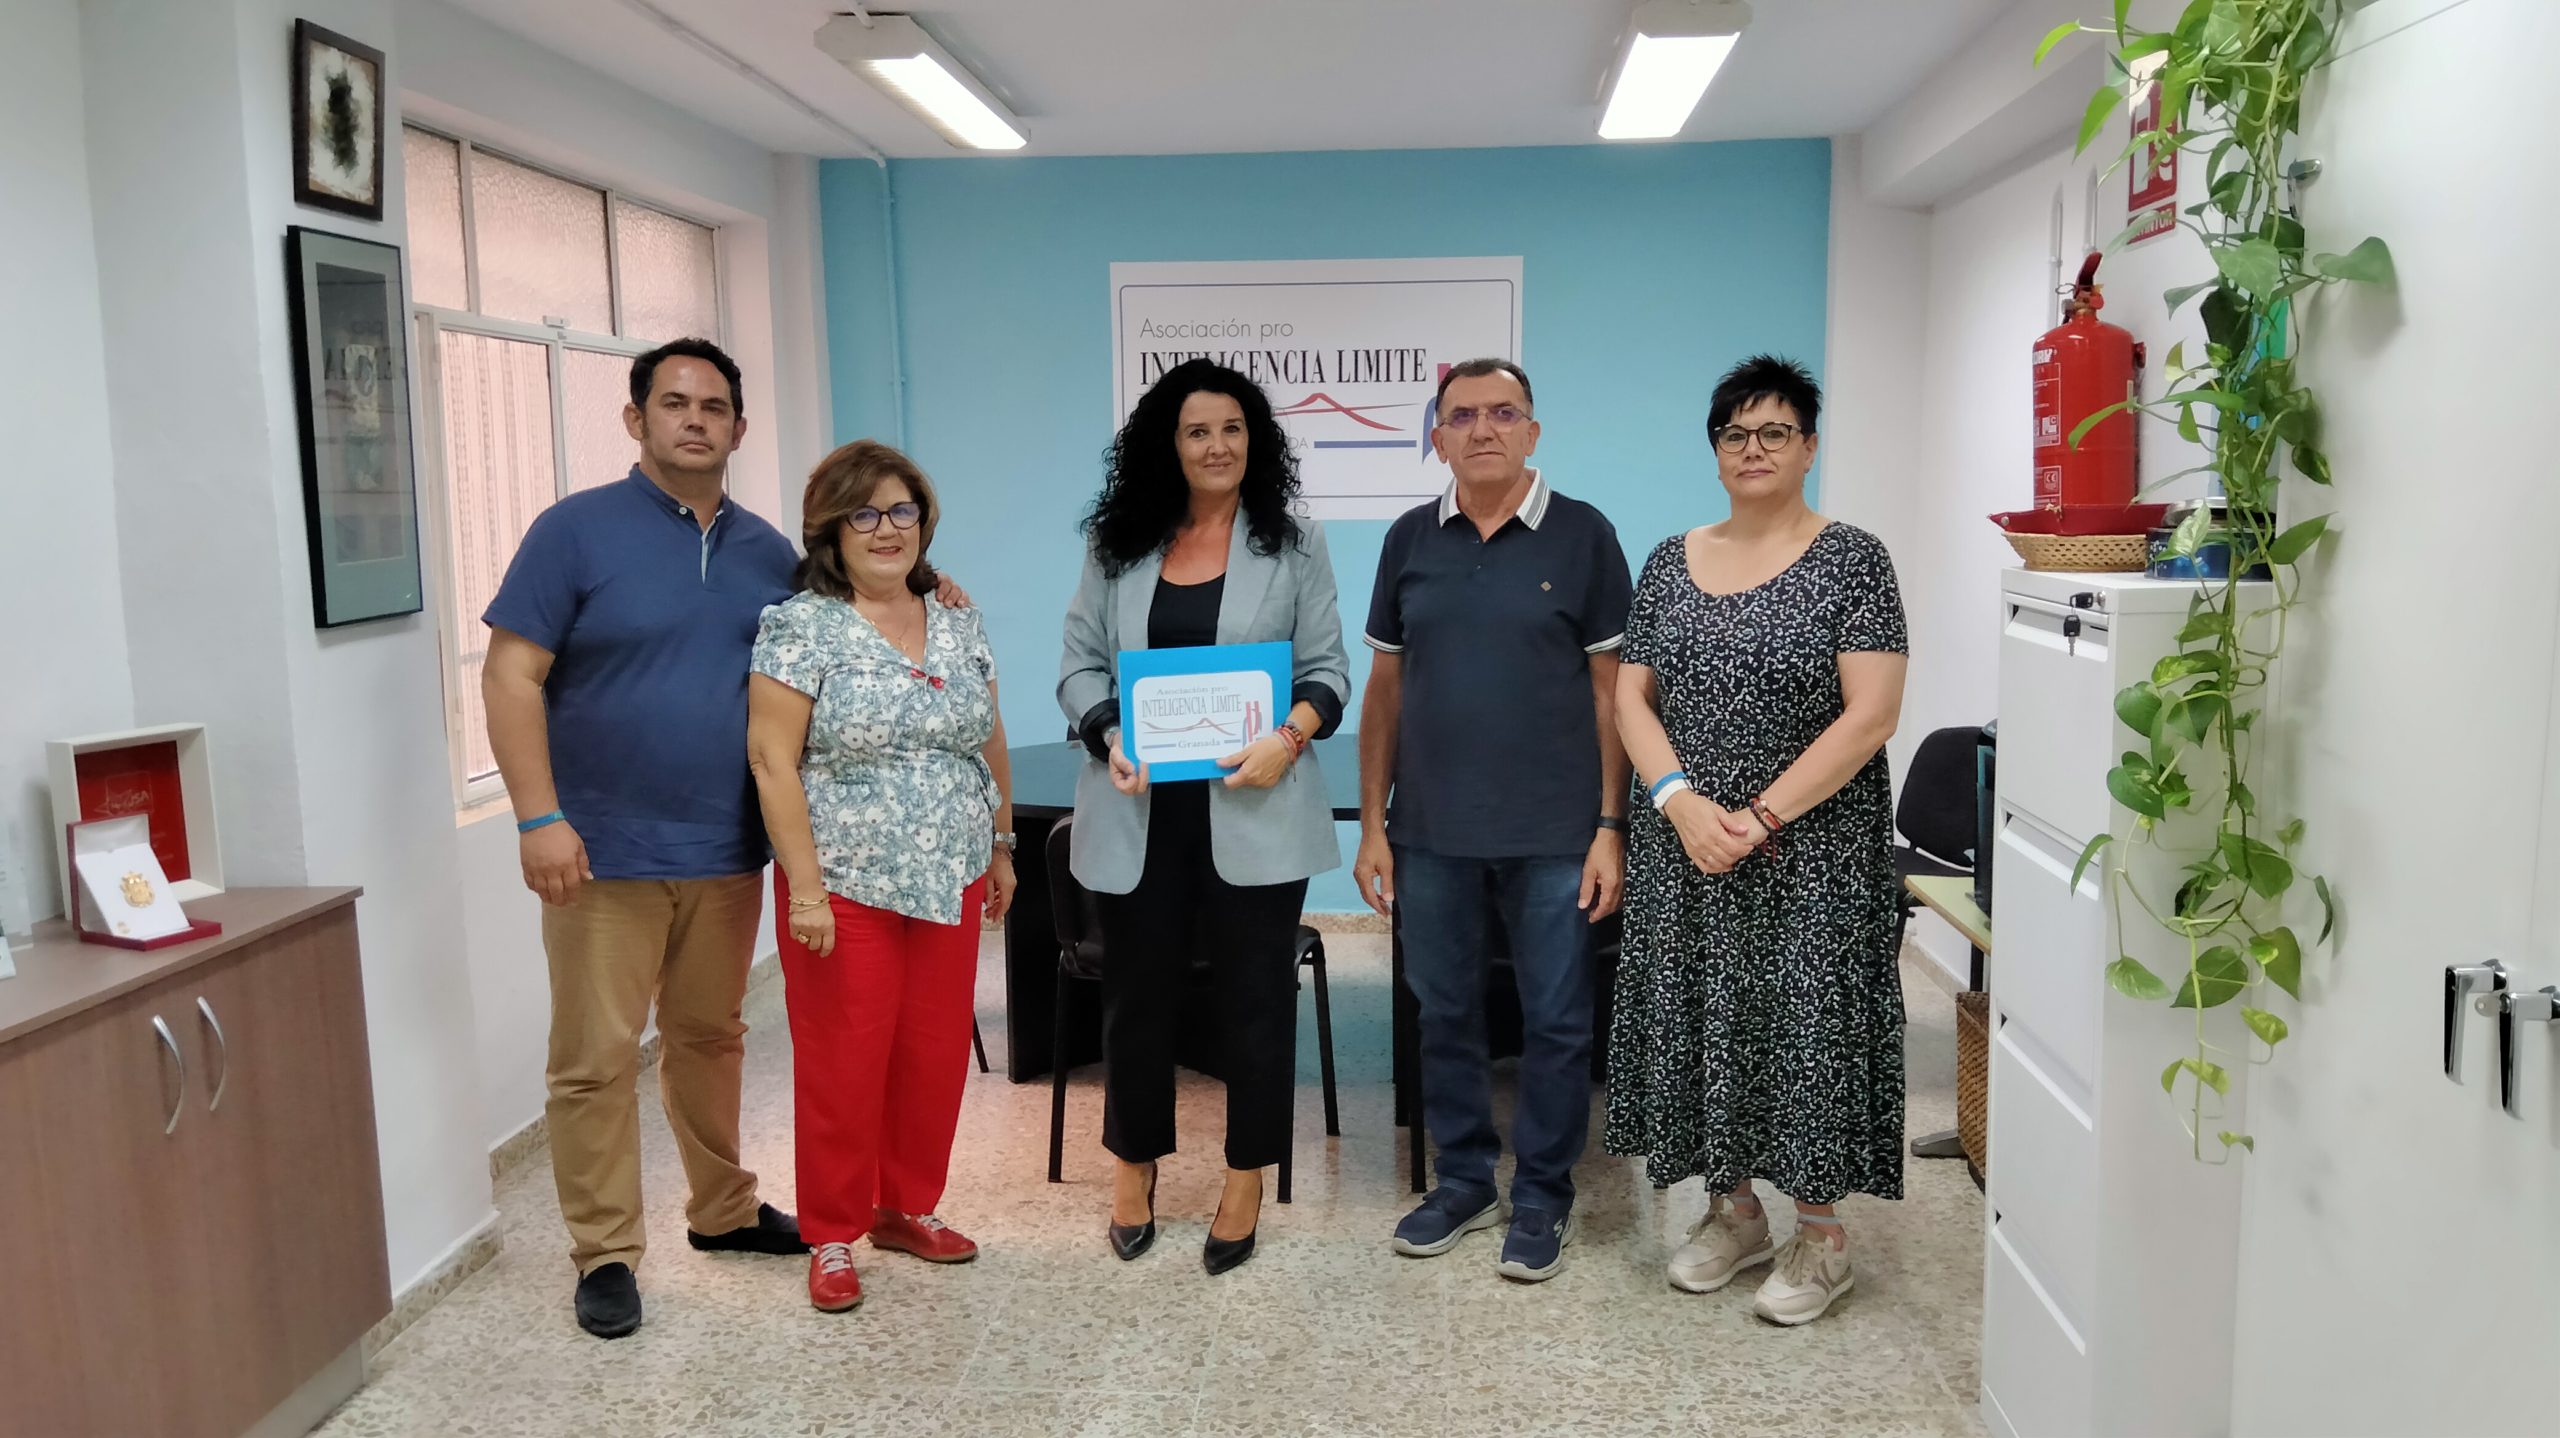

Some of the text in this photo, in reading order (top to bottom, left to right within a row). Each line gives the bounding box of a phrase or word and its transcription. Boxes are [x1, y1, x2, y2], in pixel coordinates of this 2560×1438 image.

[1139, 317, 1294, 344] Asociación pro
[1336, 348, 1427, 383] LIMITE
[1156, 686, 1209, 696] Asociación
[1141, 694, 1242, 718] INTELIGENCIA LIMITE
[1177, 738, 1221, 749] Granada
